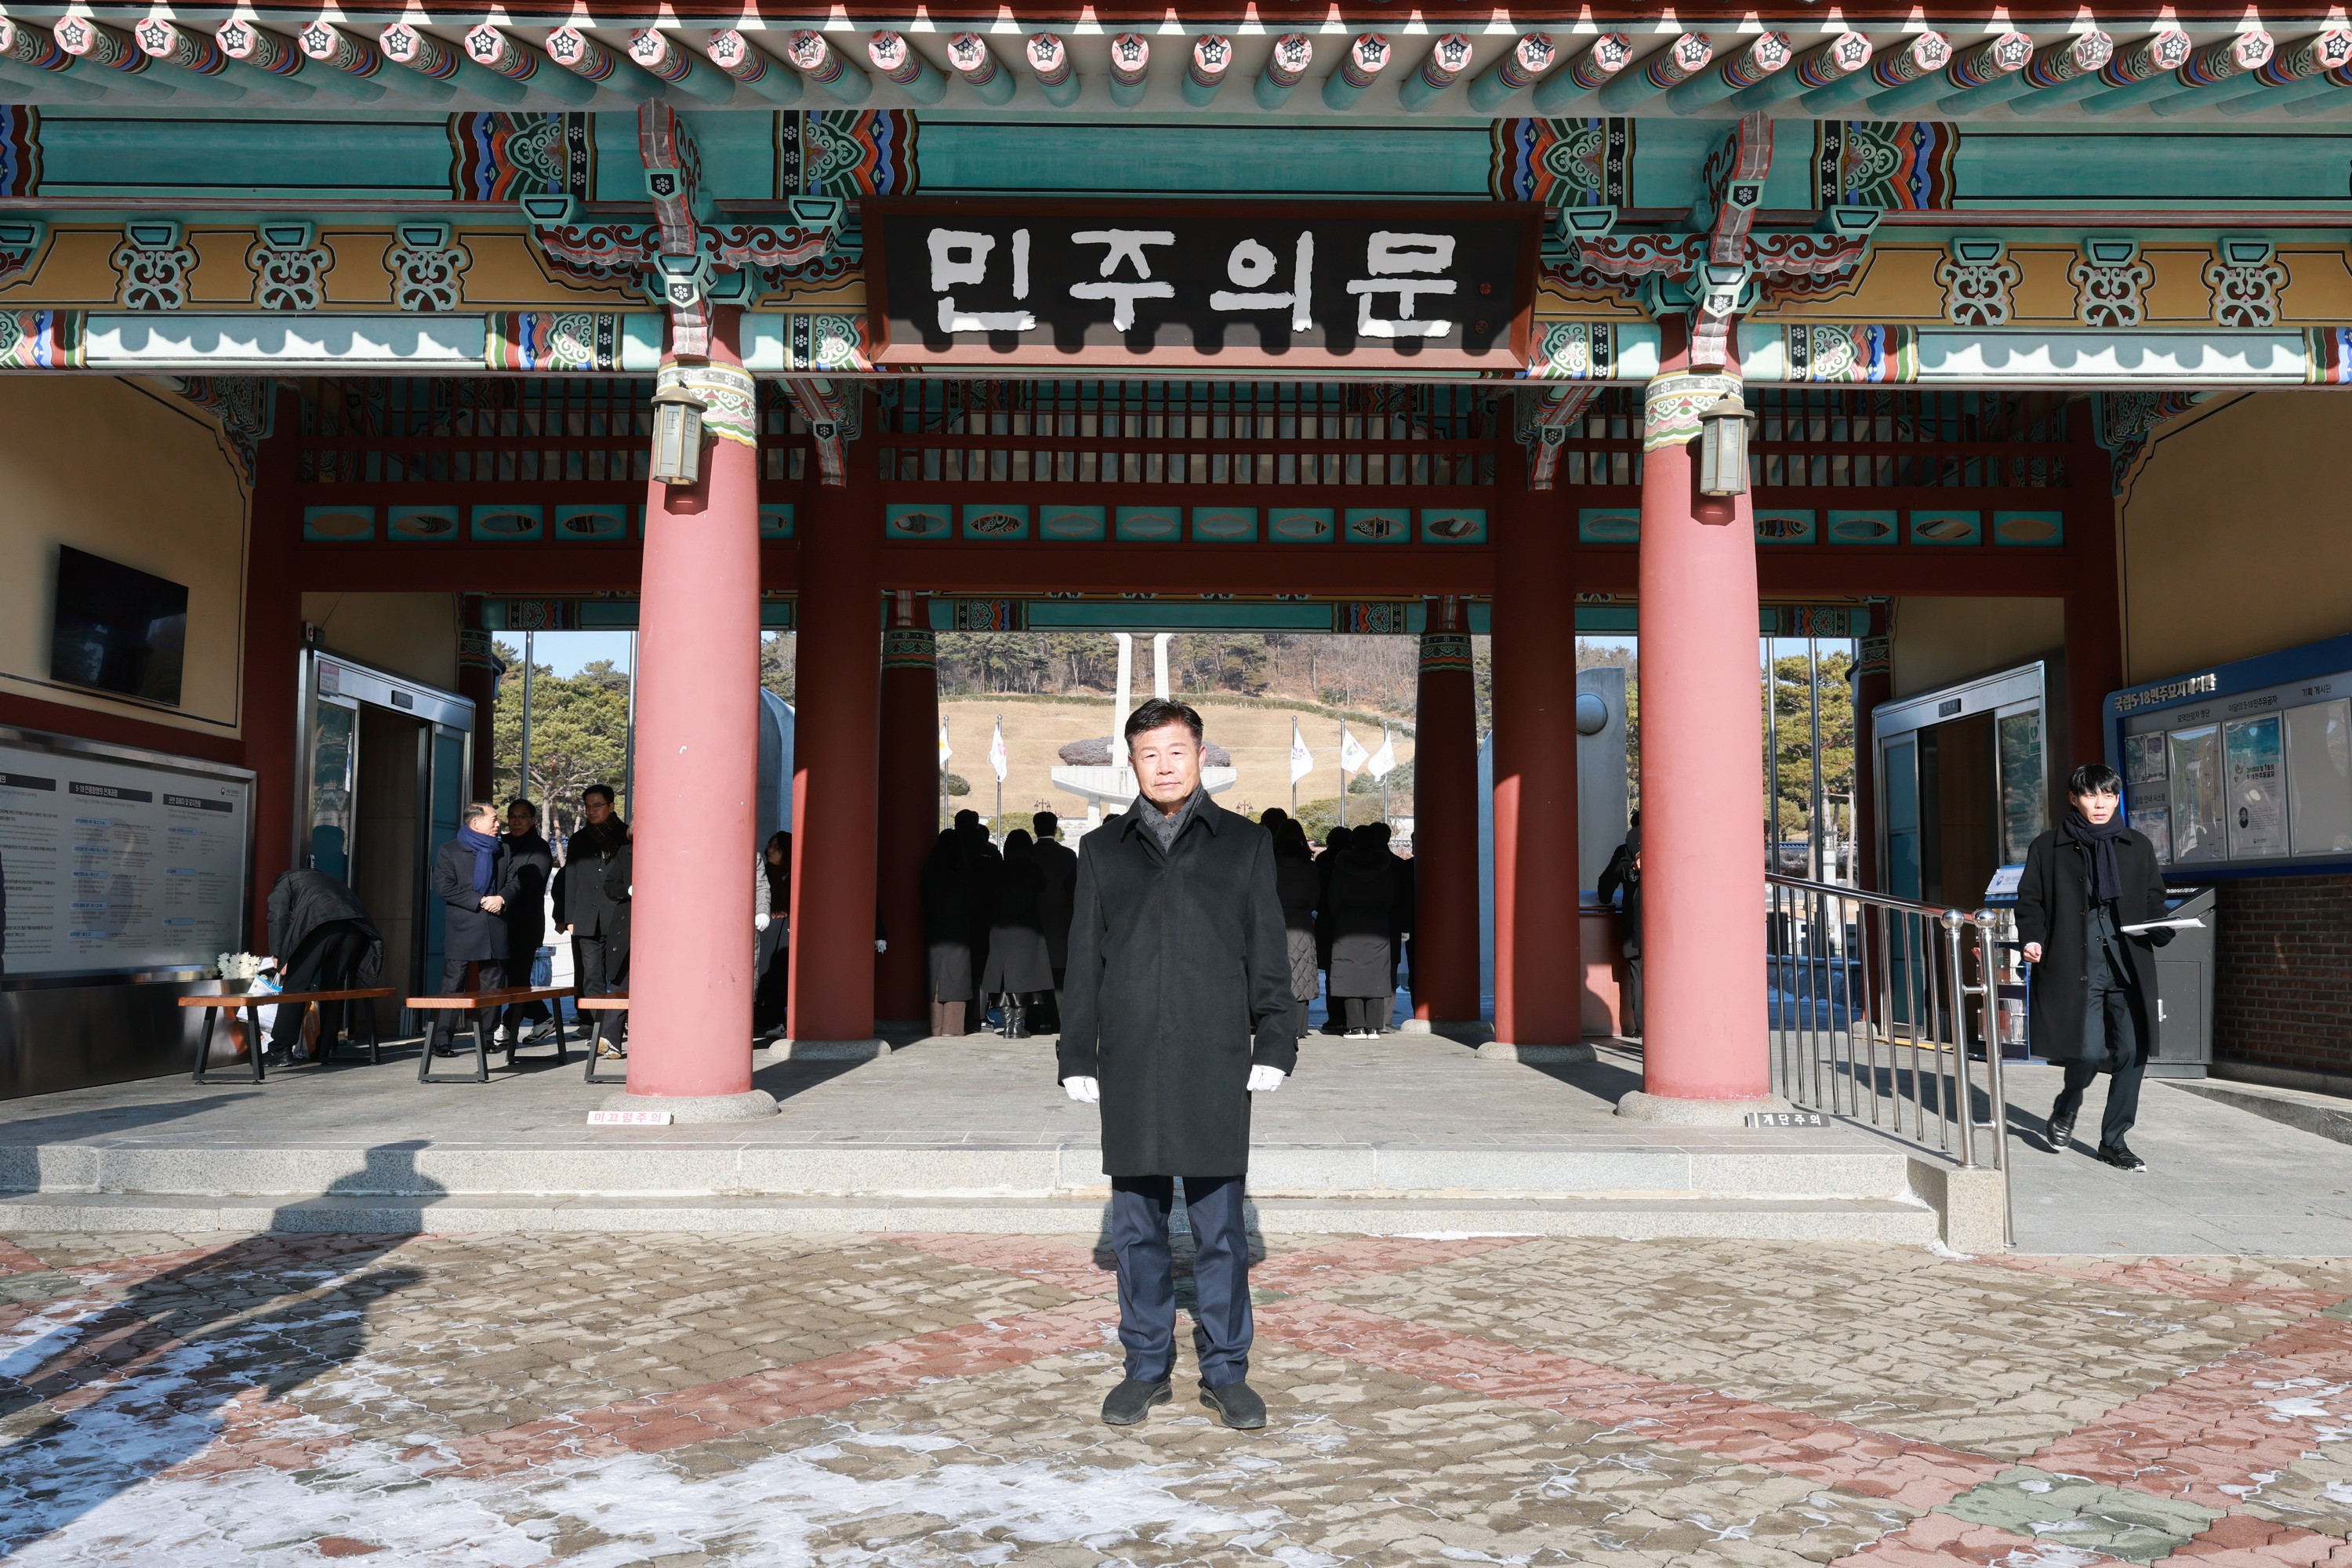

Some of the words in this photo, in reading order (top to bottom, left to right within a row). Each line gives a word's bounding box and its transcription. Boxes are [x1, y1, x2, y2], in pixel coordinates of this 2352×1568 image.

[927, 227, 1457, 339] 민주의문
[2302, 688, 2313, 697] 기획
[2314, 683, 2332, 695] 게시판
[2228, 702, 2243, 712] 이달의
[2200, 708, 2210, 719] 명단
[2144, 794, 2152, 804] 안내
[2153, 793, 2165, 802] 시스템
[593, 1112, 662, 1123] 미끄럼주의
[1762, 1113, 1821, 1126] 계단주의
